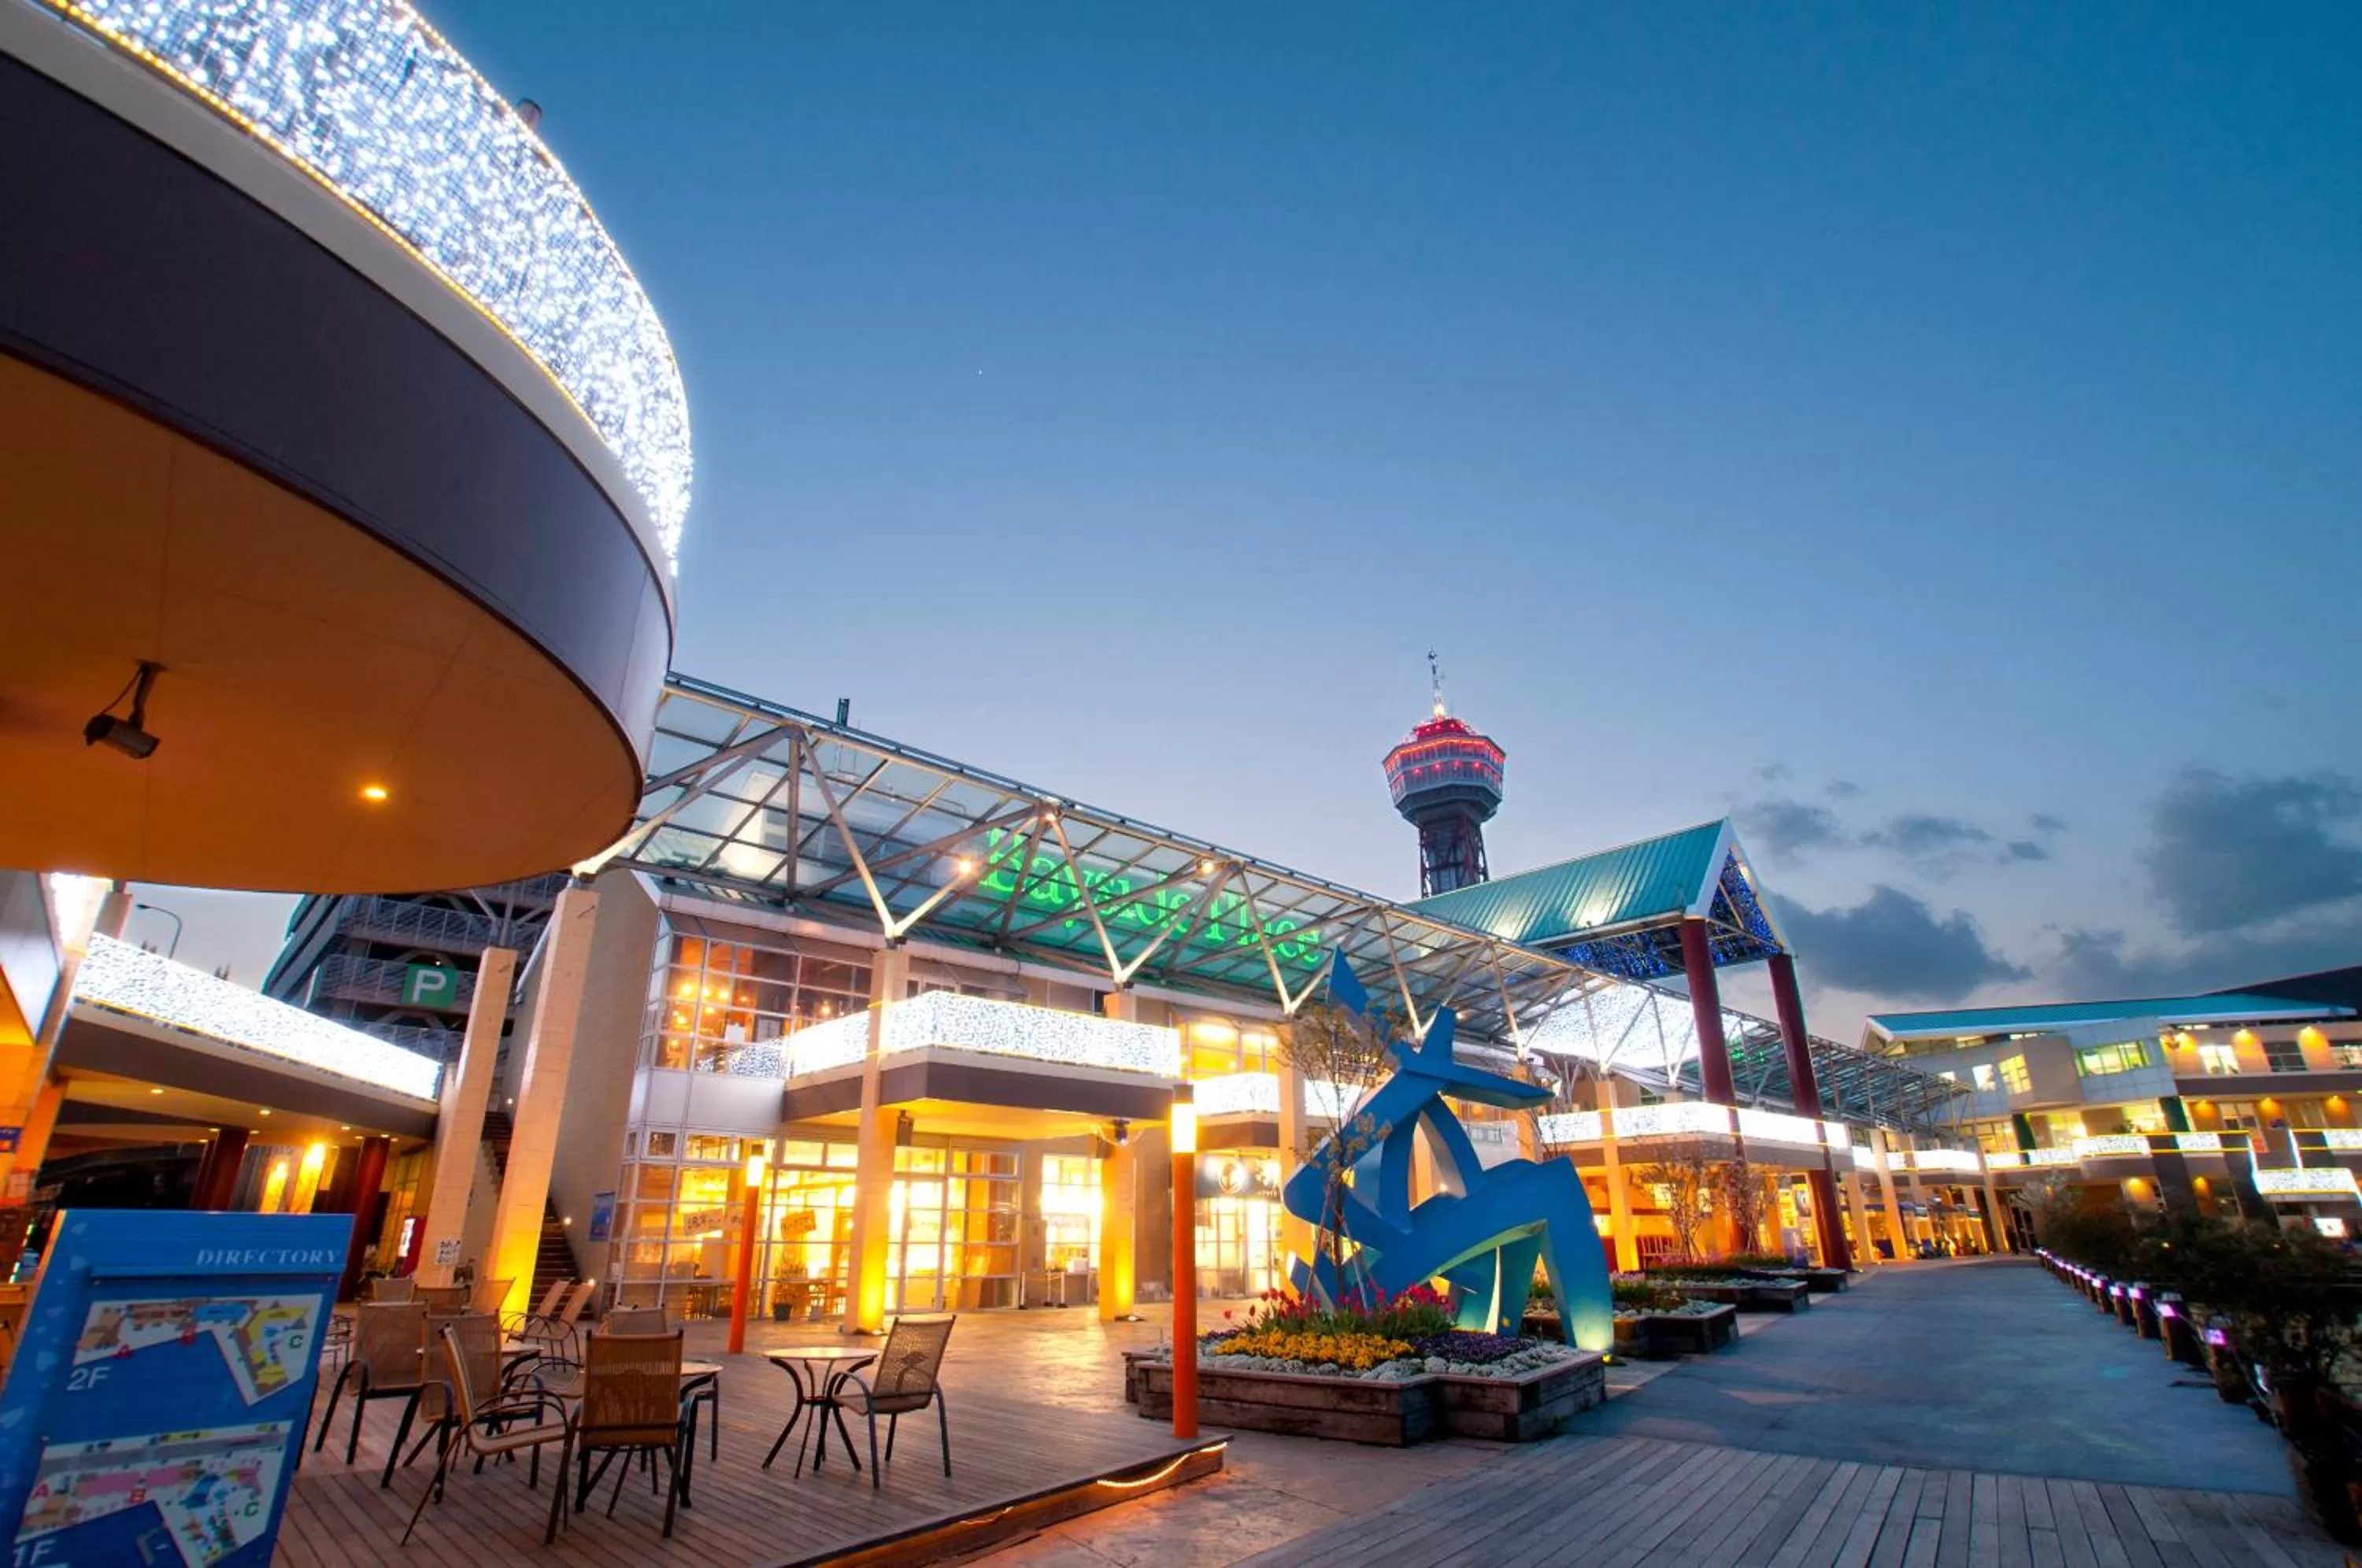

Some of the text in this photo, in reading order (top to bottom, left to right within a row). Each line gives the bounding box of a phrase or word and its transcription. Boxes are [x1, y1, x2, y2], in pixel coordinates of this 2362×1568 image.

[979, 827, 1195, 934] Bayside
[412, 969, 447, 1004] P
[197, 1248, 342, 1266] DIRECTORY
[289, 1335, 304, 1348] C
[66, 1366, 112, 1391] 2F
[244, 1501, 260, 1518] C
[12, 1539, 57, 1568] 1F
